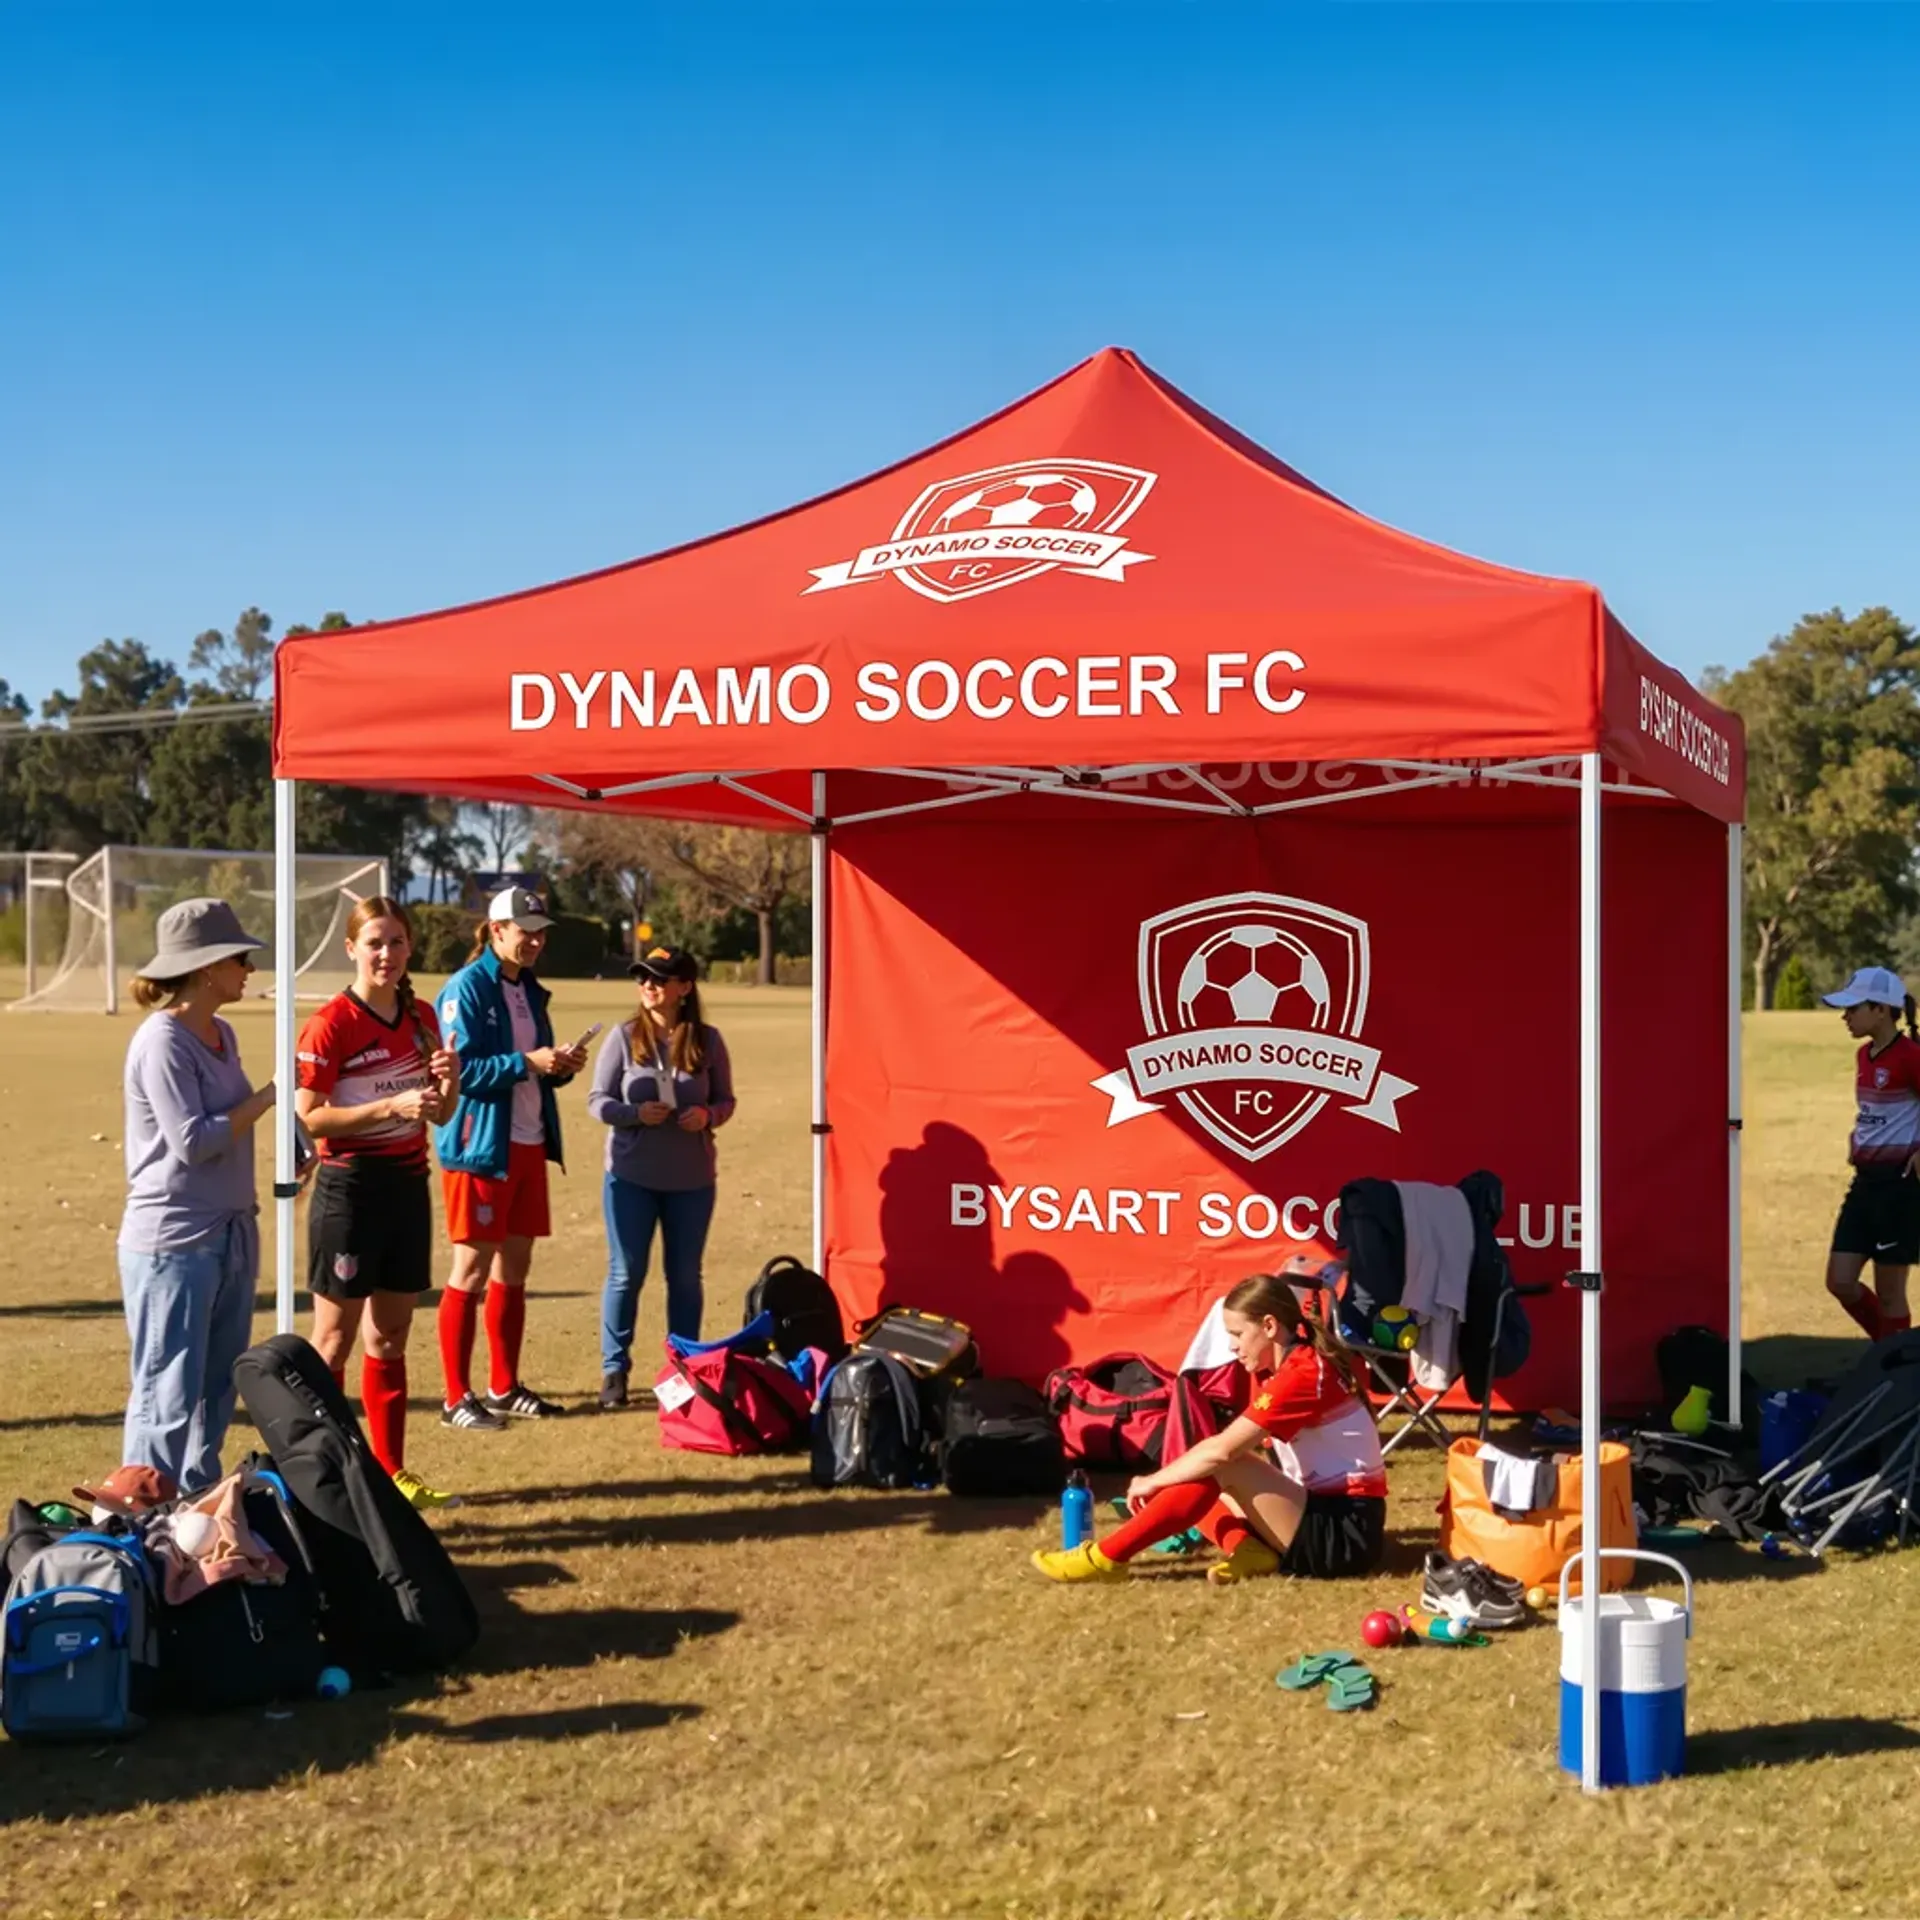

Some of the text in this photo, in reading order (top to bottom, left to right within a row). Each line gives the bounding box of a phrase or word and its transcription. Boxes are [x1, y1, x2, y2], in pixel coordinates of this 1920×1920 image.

[872, 536, 1102, 566] DYNAMO SOCCER
[948, 563, 992, 581] FC
[510, 650, 1306, 731] DYNAMO SOCCER FC
[1143, 1043, 1364, 1082] DYNAMO SOCCER
[1235, 1089, 1274, 1116] FC
[951, 1183, 1181, 1235] BYSART
[1198, 1192, 1341, 1241] SOCC
